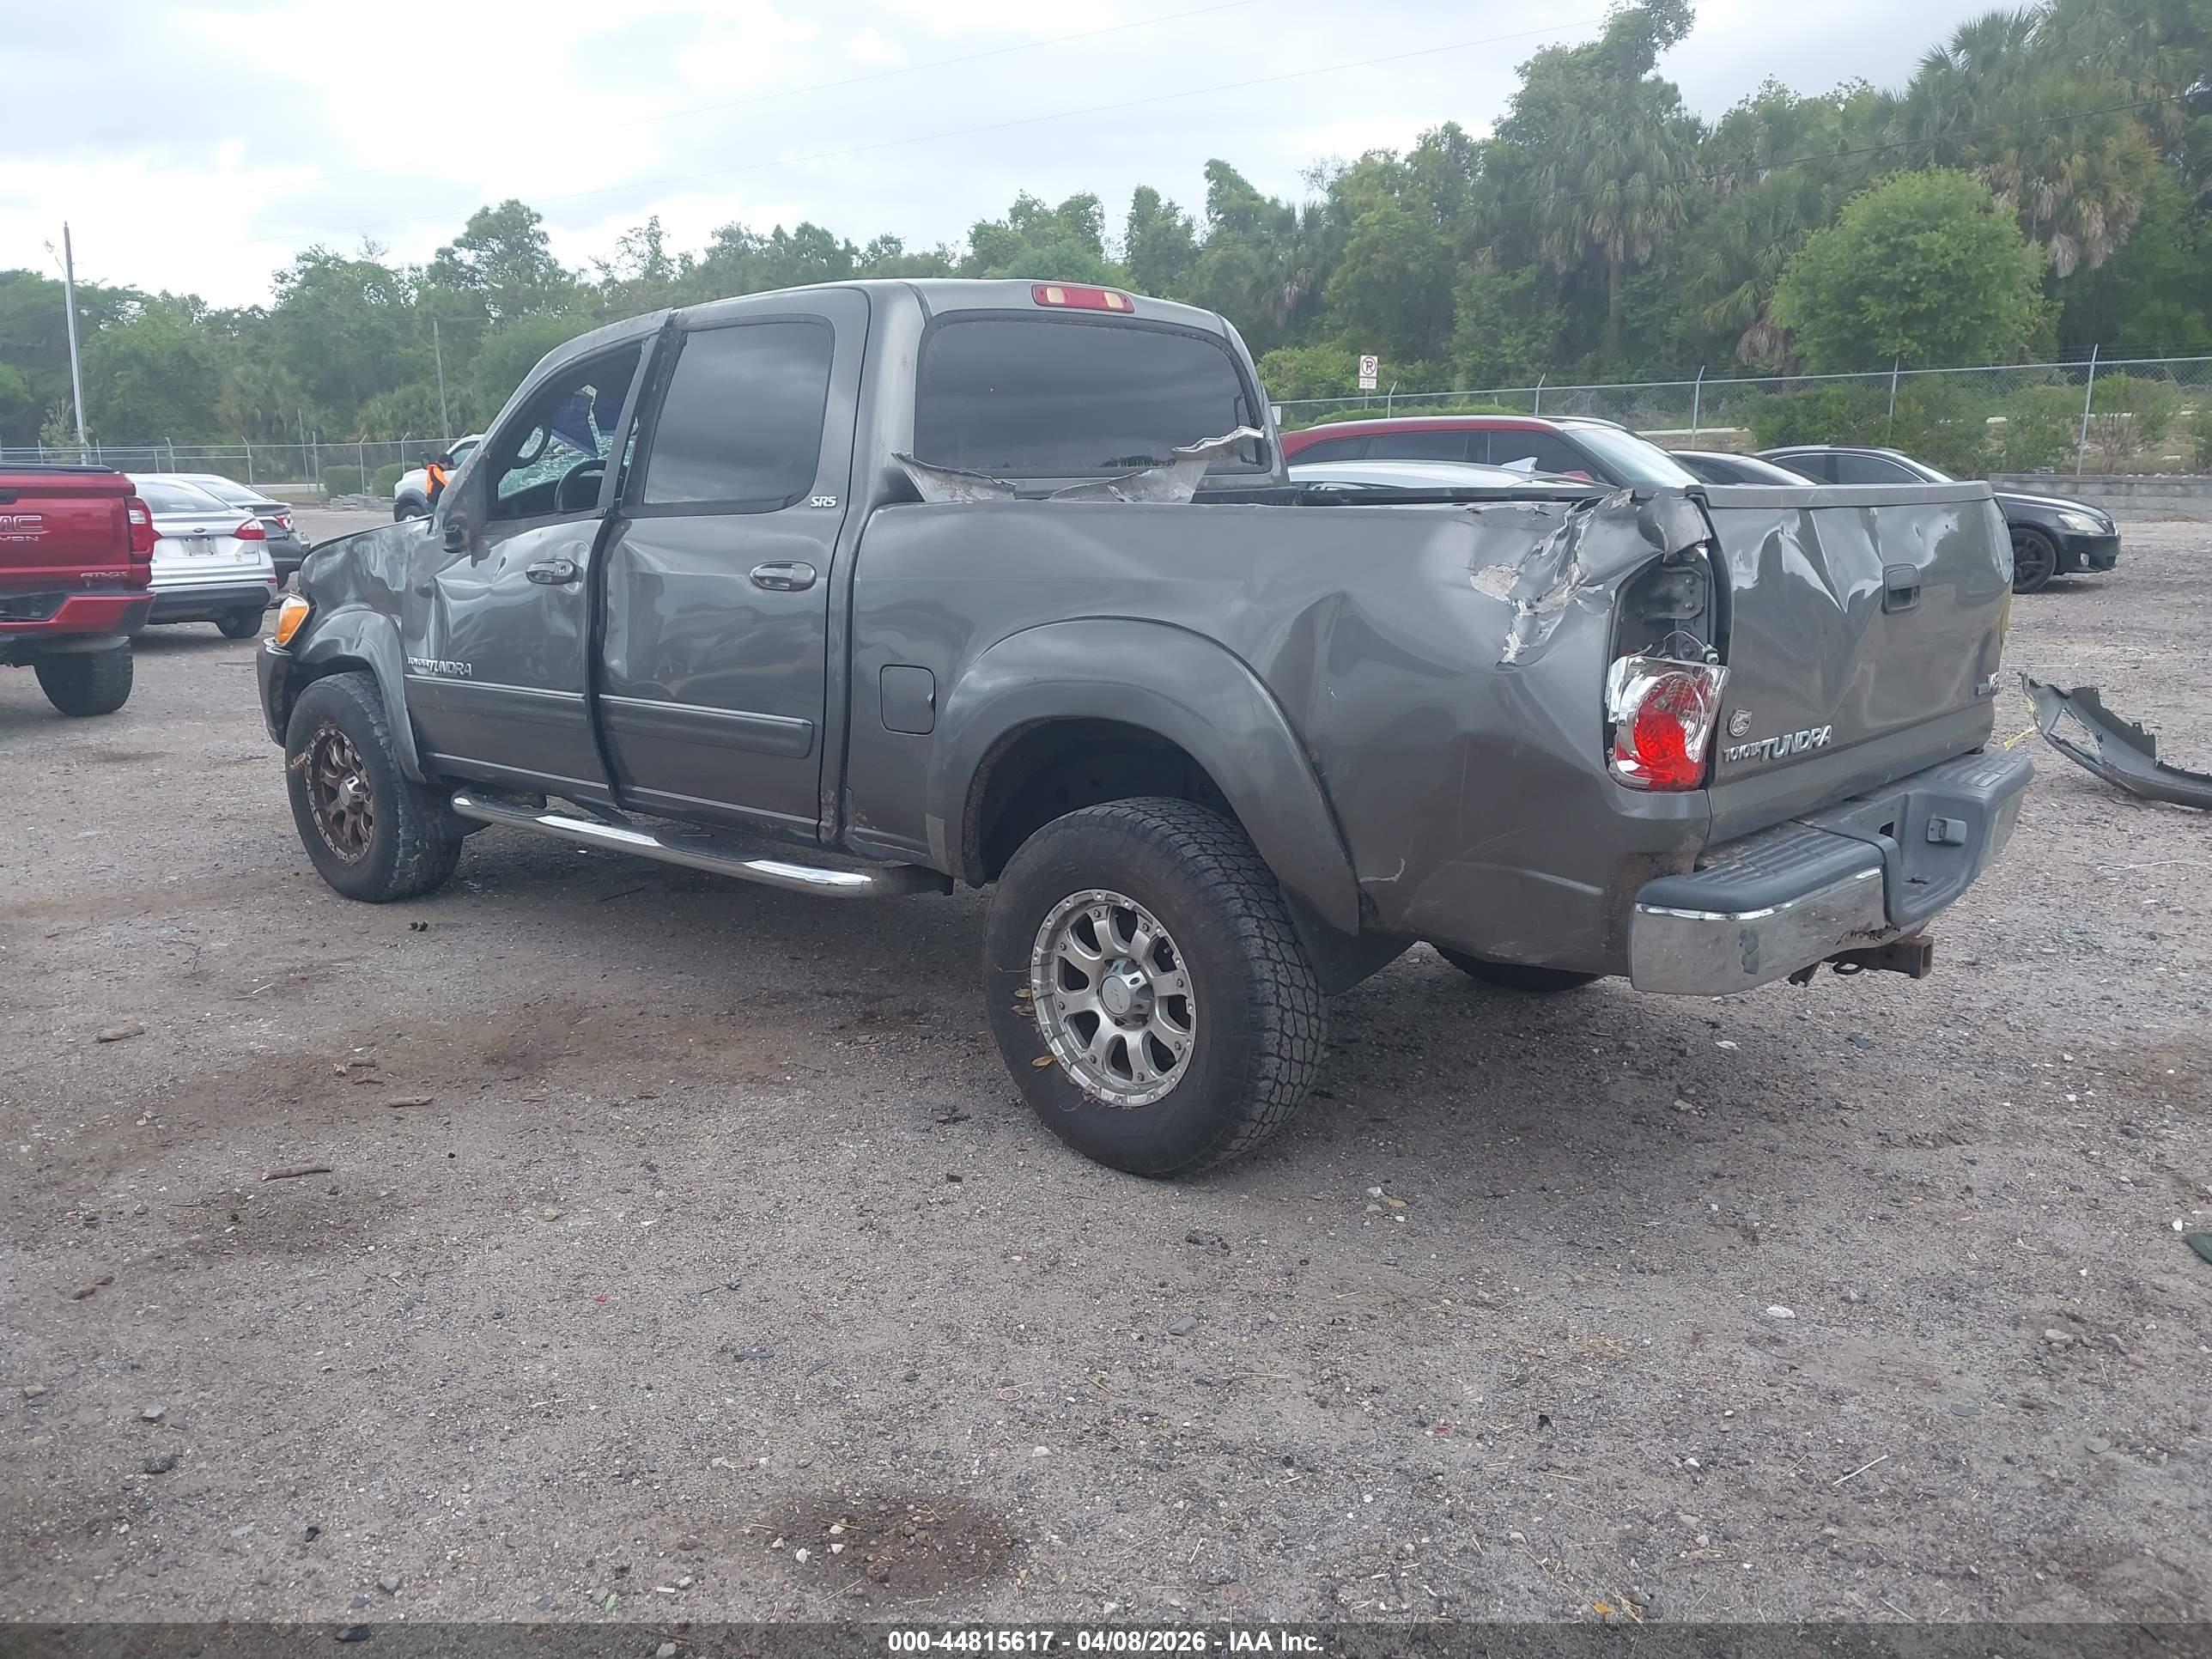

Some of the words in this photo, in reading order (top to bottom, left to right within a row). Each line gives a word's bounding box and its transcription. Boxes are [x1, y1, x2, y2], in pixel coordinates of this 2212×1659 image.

[811, 495, 837, 507] SR5
[407, 656, 430, 667] TOYOTA
[429, 659, 473, 677] TUNDRA
[1723, 741, 1763, 763] TOYOTA
[1759, 724, 1832, 763] TUNDRA
